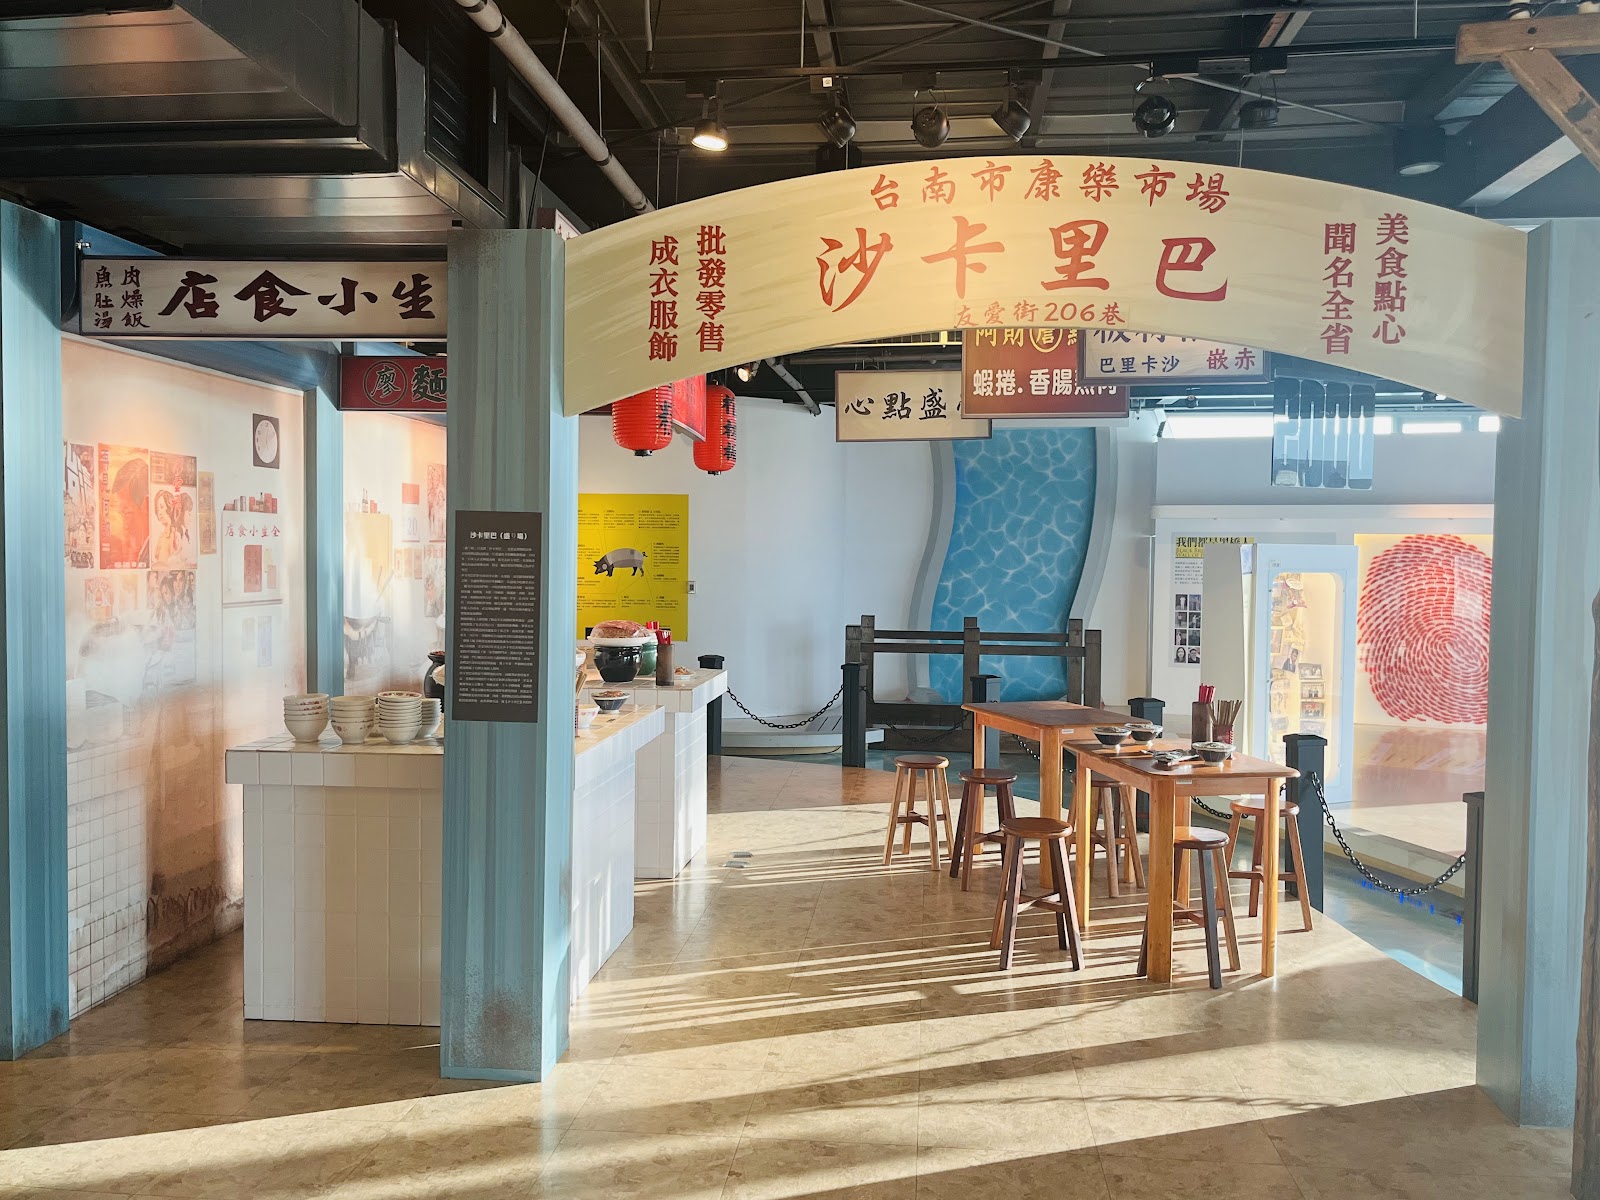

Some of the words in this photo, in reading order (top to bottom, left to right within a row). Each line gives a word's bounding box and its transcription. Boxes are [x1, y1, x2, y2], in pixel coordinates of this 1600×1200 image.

[870, 158, 1230, 214] 台南市康樂市場
[94, 266, 114, 329] 魚肚湯
[121, 266, 150, 328] 肉燥飯
[648, 235, 679, 362] 成衣服飾
[696, 225, 727, 353] 批發零售
[816, 214, 1229, 313] 沙卡里巴
[1320, 222, 1357, 355] 聞名全省
[1372, 212, 1409, 345] 美食點心
[956, 302, 1126, 327] 友愛街206巷
